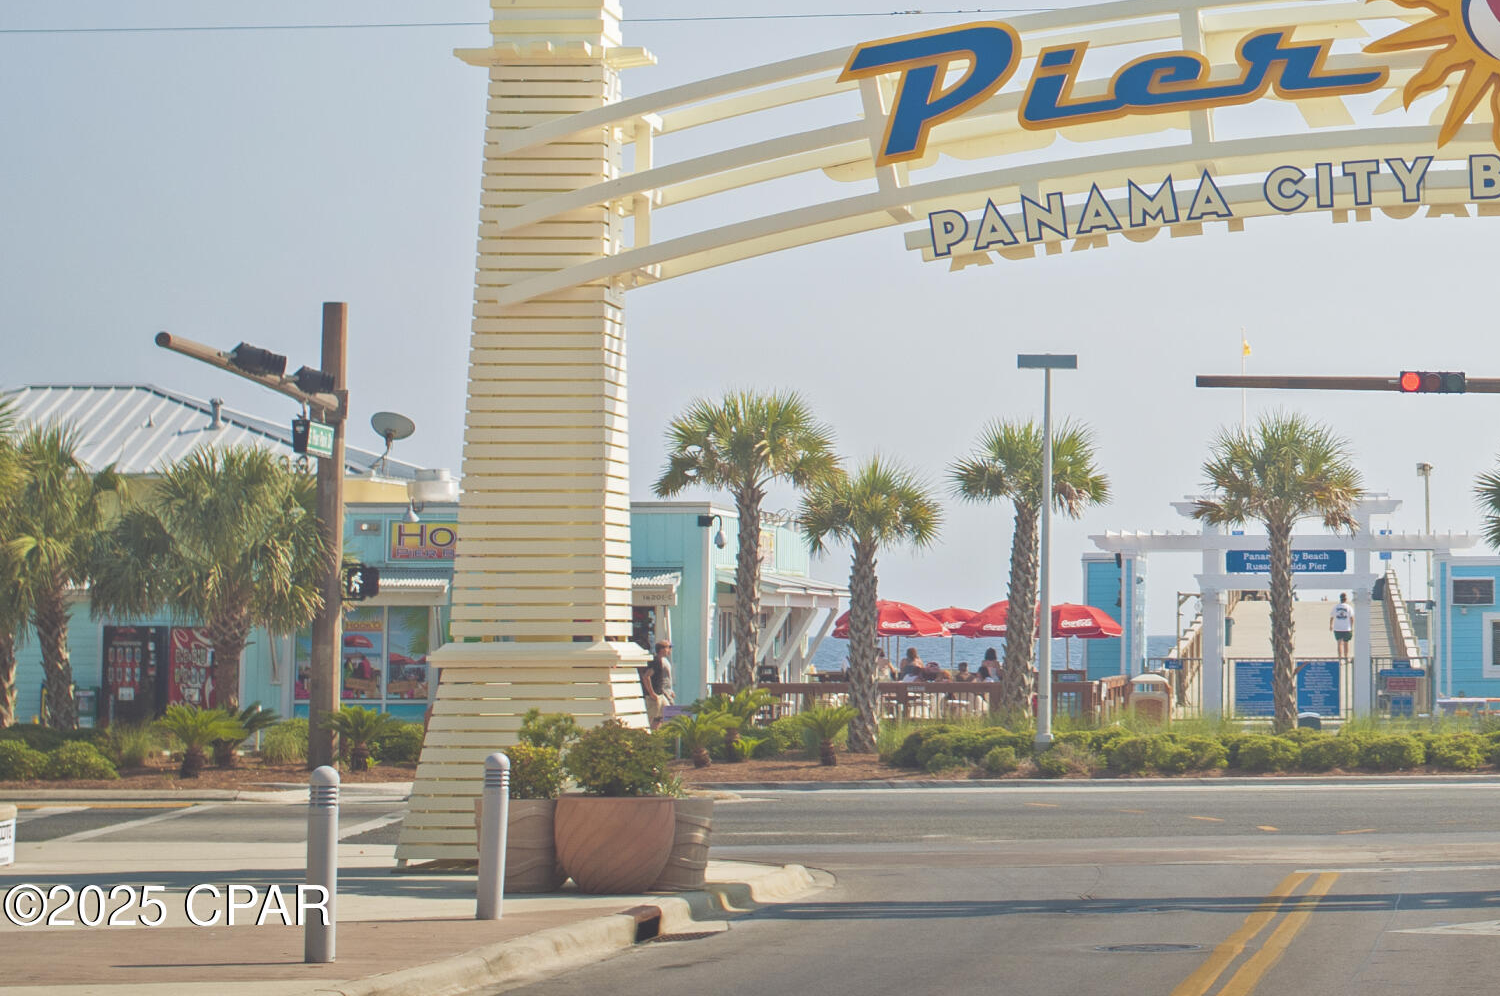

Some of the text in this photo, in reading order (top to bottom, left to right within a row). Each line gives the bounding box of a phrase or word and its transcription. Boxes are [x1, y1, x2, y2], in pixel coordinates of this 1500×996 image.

[837, 20, 1390, 166] Pier
[928, 169, 1233, 258] PANAMA
[1262, 155, 1434, 213] CITY
